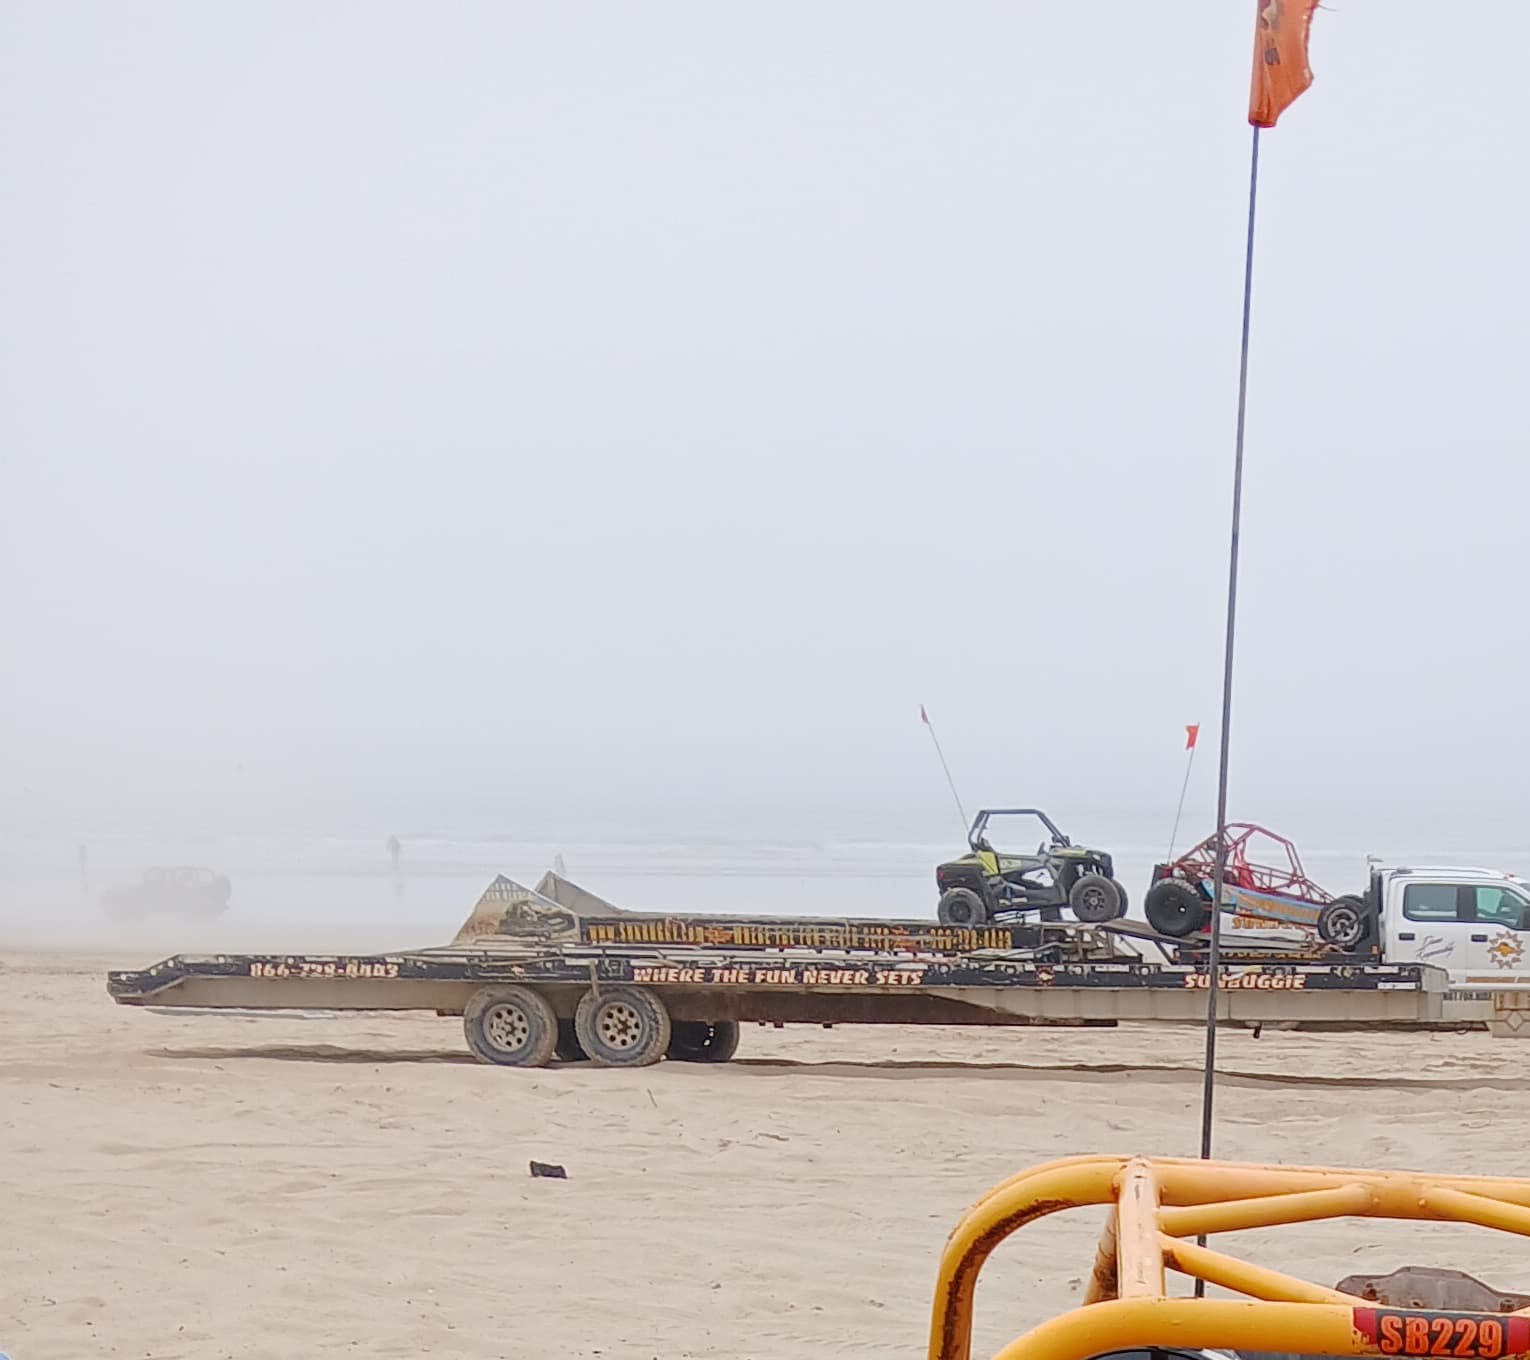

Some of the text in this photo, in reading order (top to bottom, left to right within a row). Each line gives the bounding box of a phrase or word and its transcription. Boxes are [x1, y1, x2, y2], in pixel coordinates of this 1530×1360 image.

[634, 968, 923, 985] WHERE THE FUN NEVER SETS
[1380, 1315, 1503, 1358] SB229
